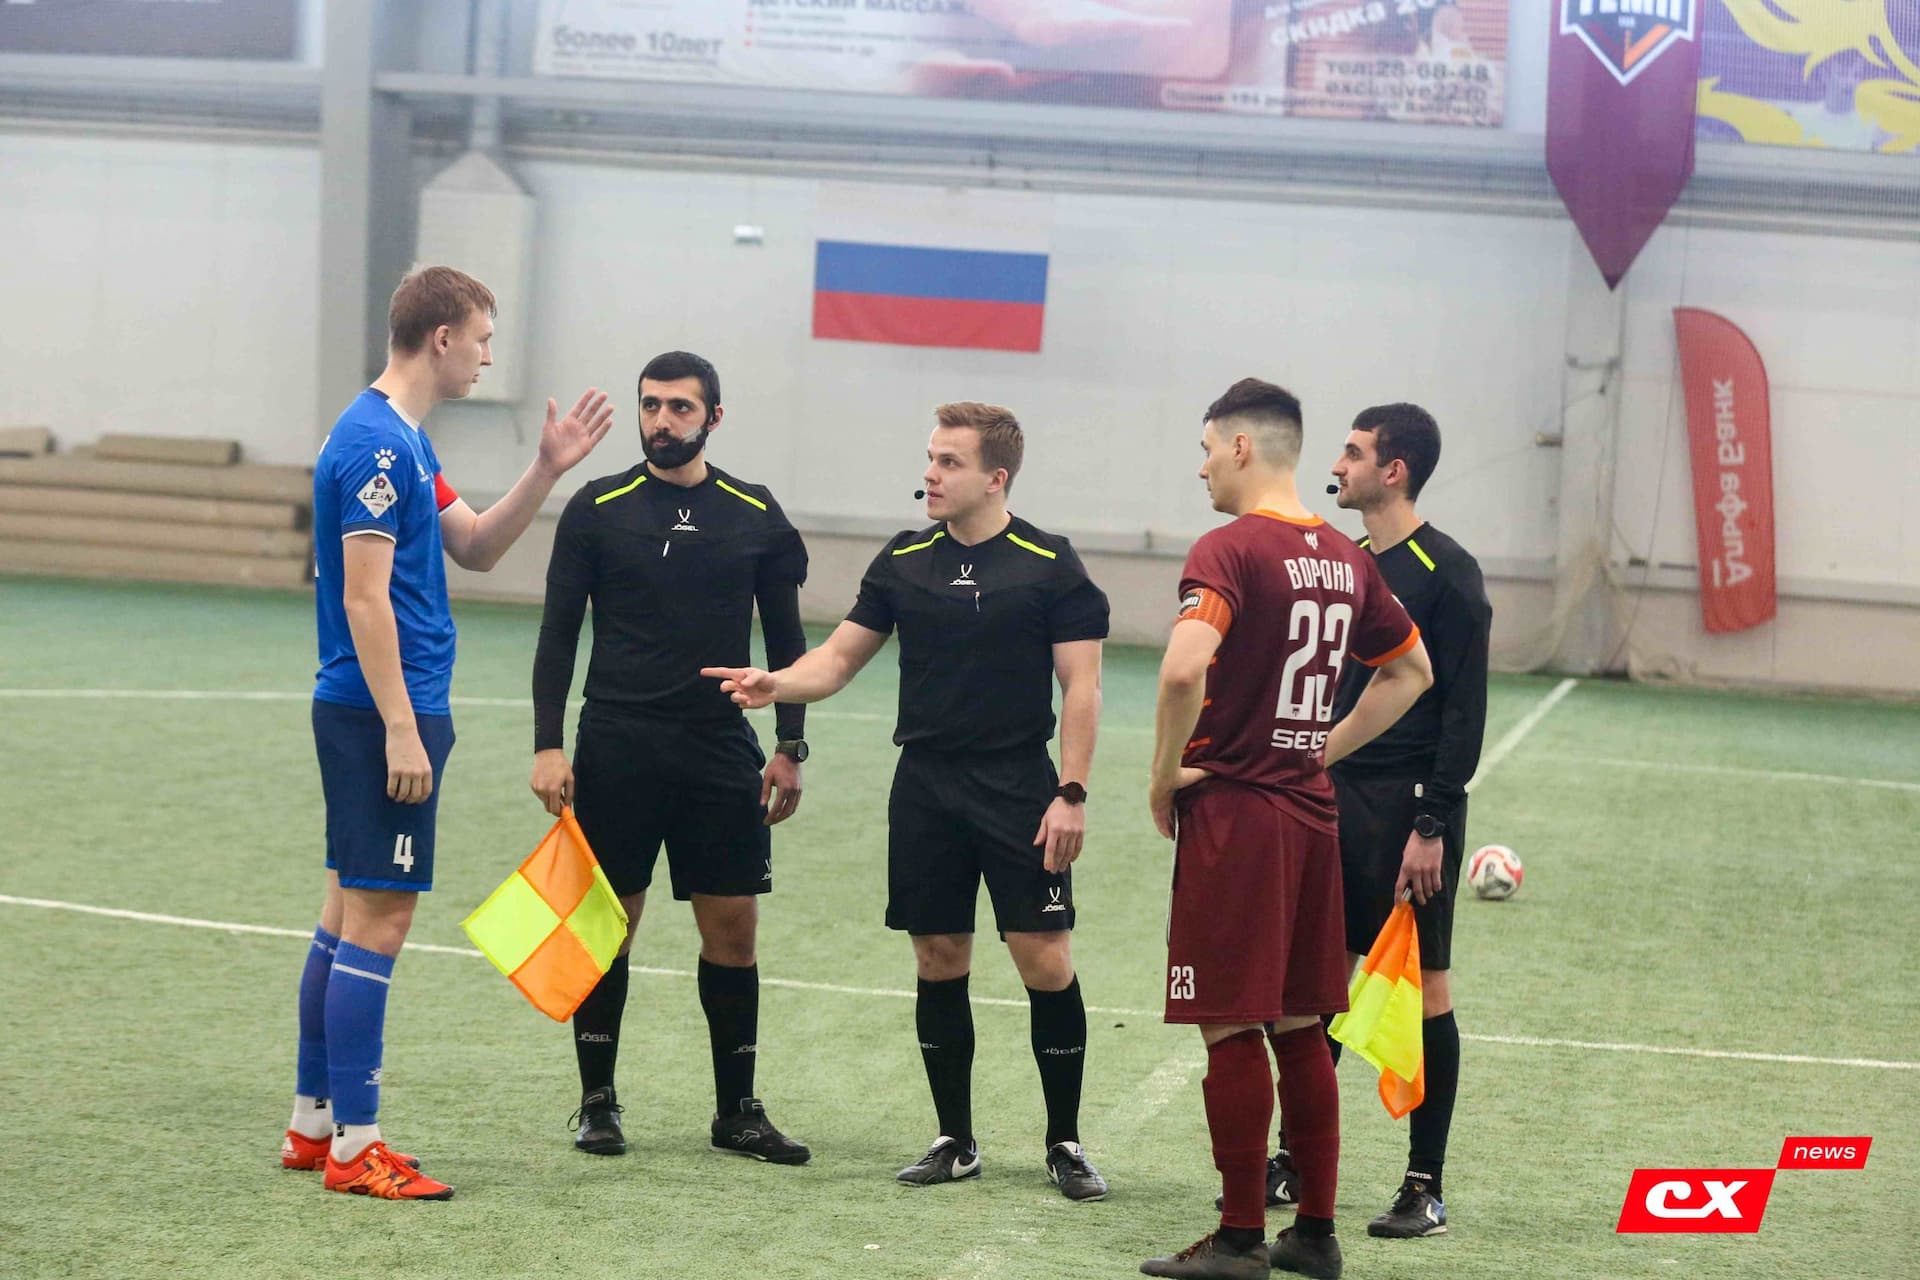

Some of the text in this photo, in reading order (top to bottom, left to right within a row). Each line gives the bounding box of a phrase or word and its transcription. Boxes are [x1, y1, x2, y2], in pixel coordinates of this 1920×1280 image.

[1284, 556, 1355, 595] ВОРОНА
[1275, 600, 1353, 723] 23
[392, 833, 415, 873] 4
[1170, 965, 1195, 1000] 23
